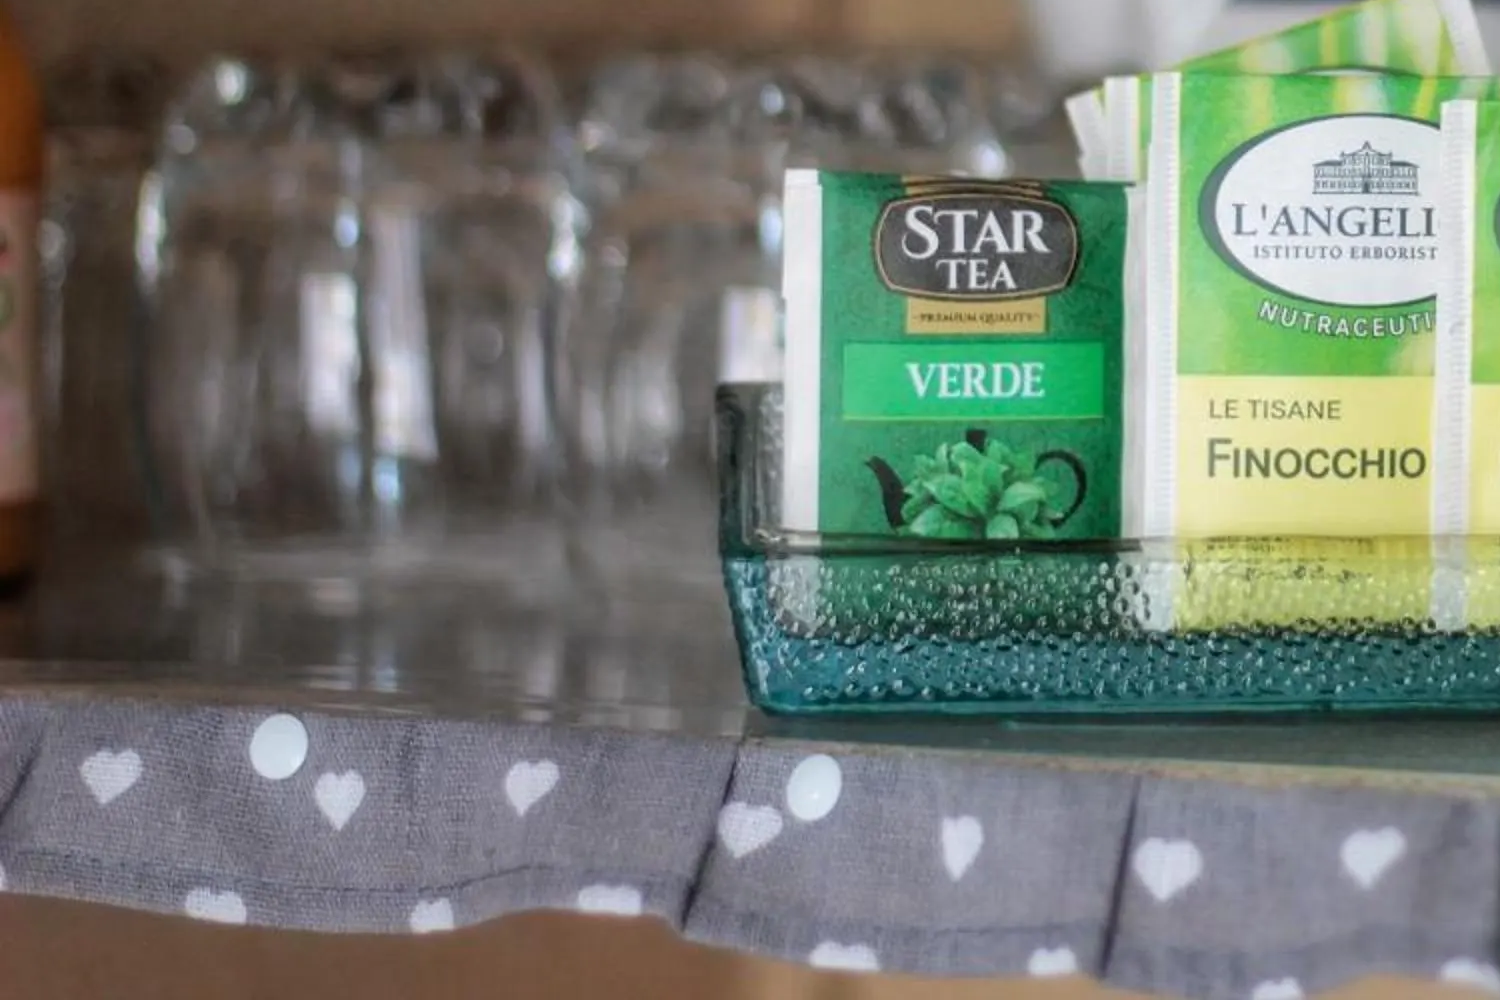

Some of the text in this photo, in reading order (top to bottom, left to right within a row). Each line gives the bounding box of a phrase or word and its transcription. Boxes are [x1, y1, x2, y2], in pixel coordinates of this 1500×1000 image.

[901, 205, 1052, 260] STAR
[1231, 203, 1437, 237] L'ANGELI
[1253, 245, 1438, 261] ISTITUTO ERBORIST
[935, 258, 1018, 291] TEA
[1258, 299, 1433, 338] NUTRACEUTI
[905, 362, 1046, 399] VERDE
[1208, 399, 1342, 420] LE TISANE
[1206, 437, 1427, 480] FINOCCHIO
